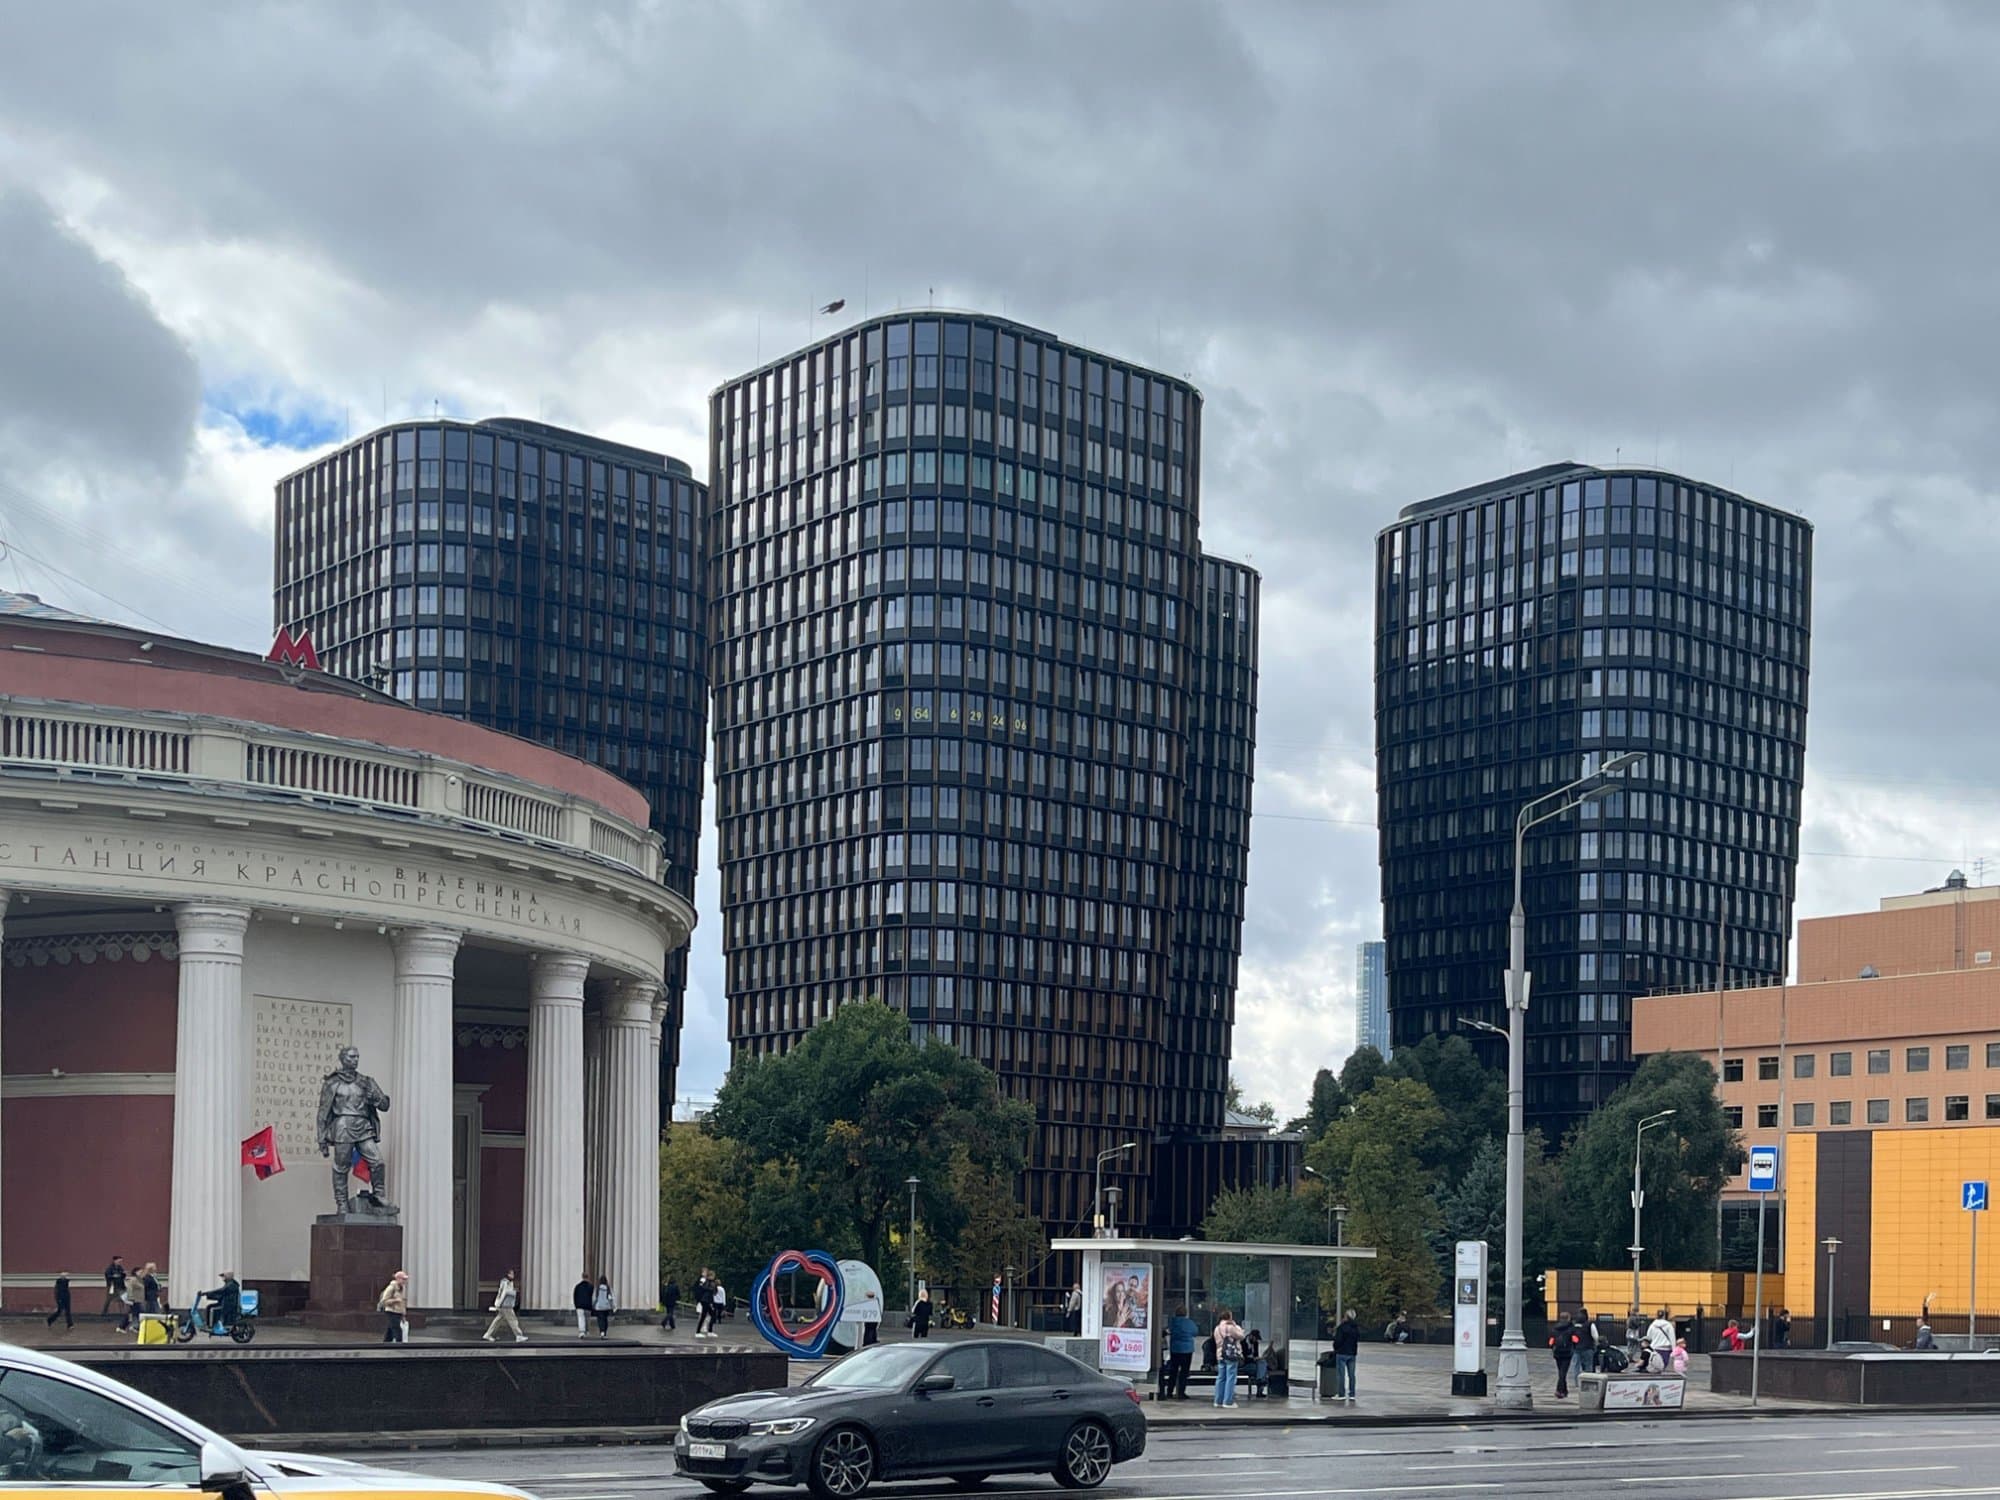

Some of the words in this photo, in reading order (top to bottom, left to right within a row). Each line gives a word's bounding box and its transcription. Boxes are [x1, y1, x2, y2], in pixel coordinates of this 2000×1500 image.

[913, 707, 930, 720] 64
[84, 835, 285, 863] МЕТРОПОЛИТЕН
[0, 842, 206, 876] СТАНЦИЯ
[237, 863, 582, 933] КРАСНОПРЕСНЕНСКАЯ
[271, 1001, 344, 1016] КРАСНАЯ
[256, 1012, 345, 1028] ПРЕСНЯ
[256, 1037, 345, 1051] КРЕПОСТЬЮ
[256, 1048, 334, 1062] ВОССТАНИ
[254, 1109, 312, 1120] ДРУЖИ
